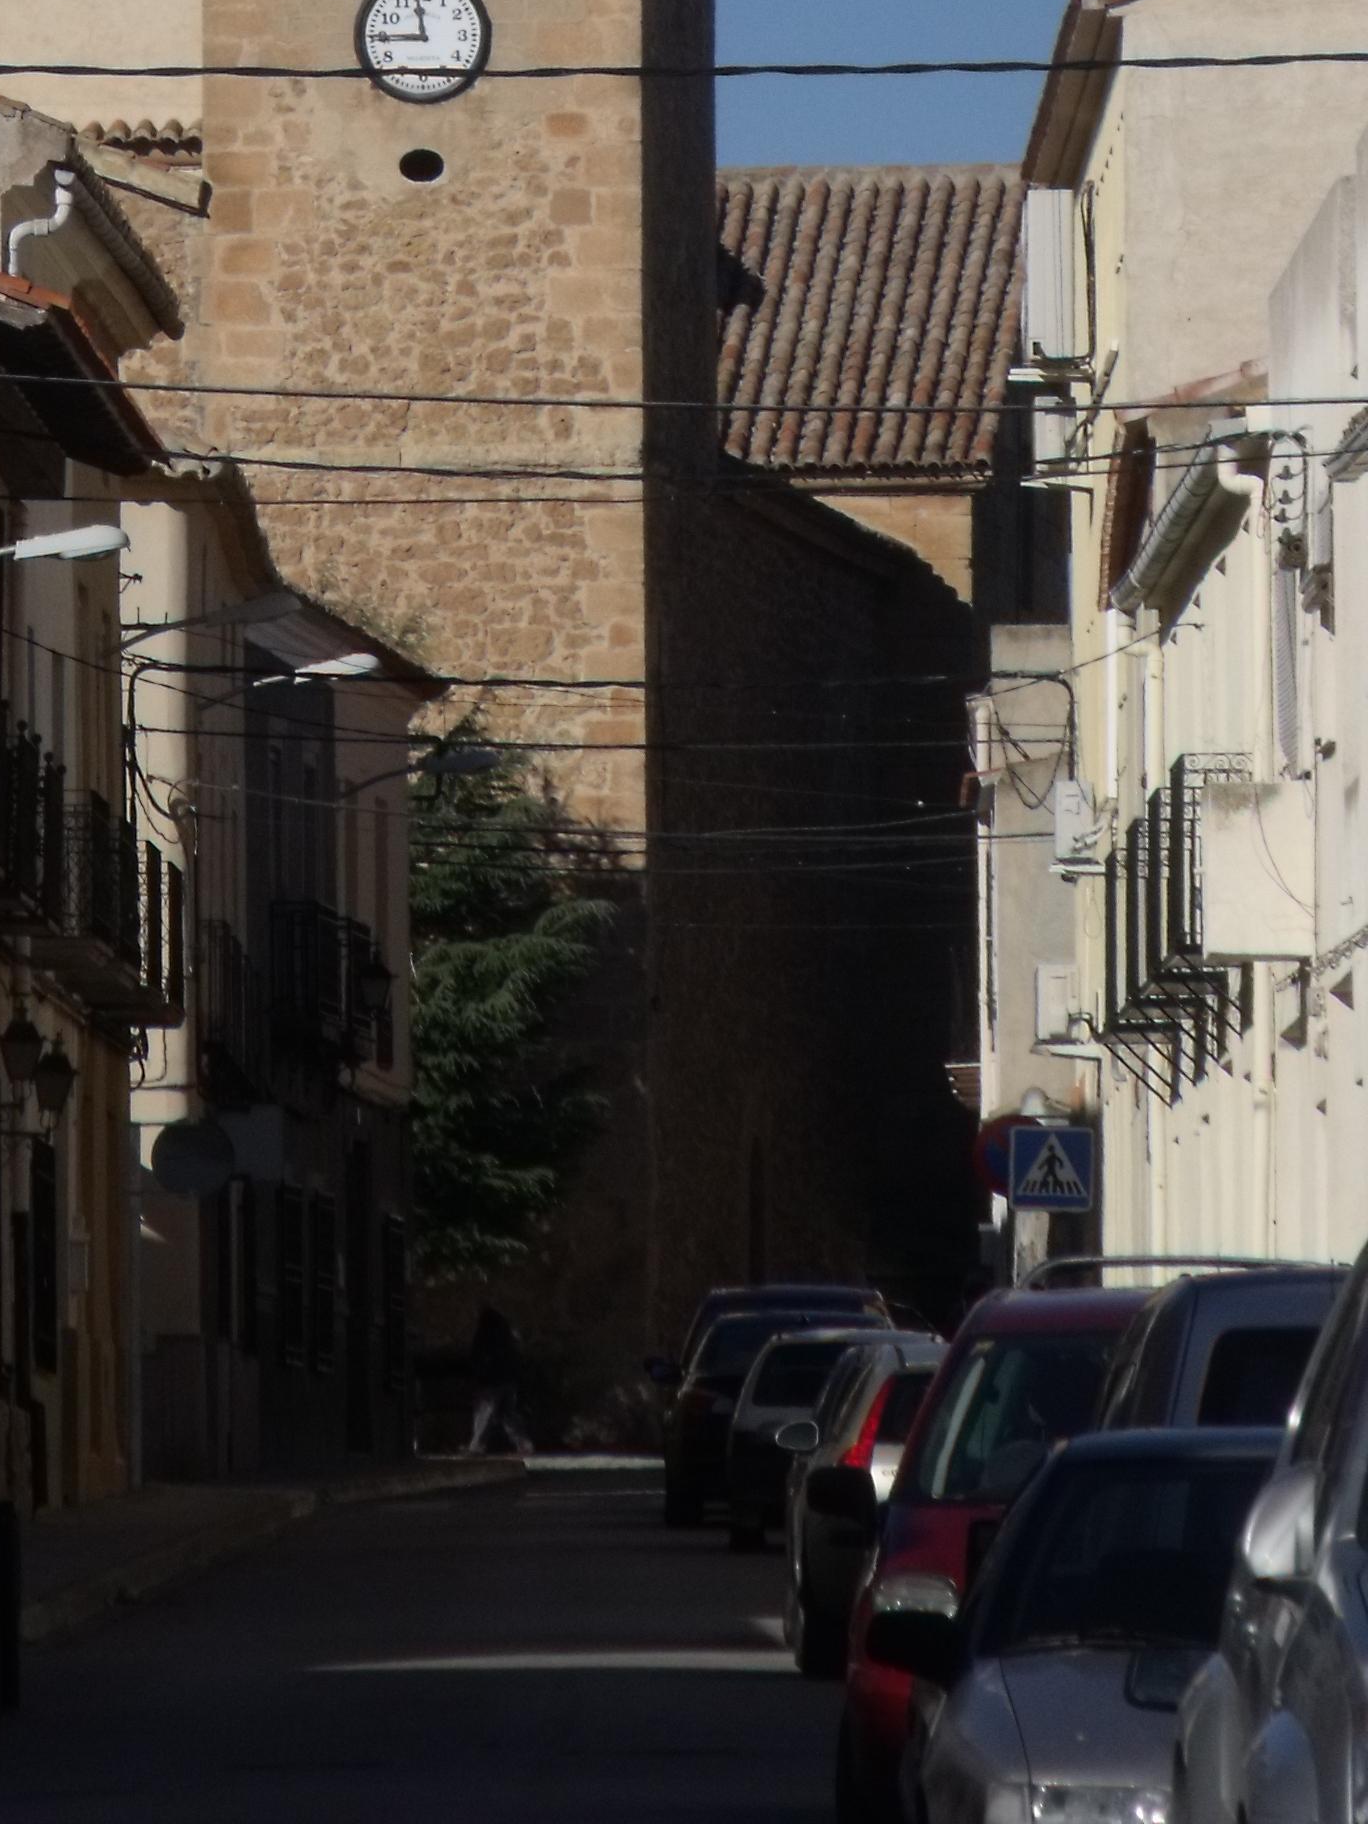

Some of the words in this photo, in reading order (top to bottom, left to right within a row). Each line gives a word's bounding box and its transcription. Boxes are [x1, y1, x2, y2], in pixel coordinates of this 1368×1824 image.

[382, 12, 401, 25] 10
[452, 8, 462, 20] 2
[458, 29, 468, 42] 3
[383, 50, 393, 63] 8
[450, 50, 461, 62] 4
